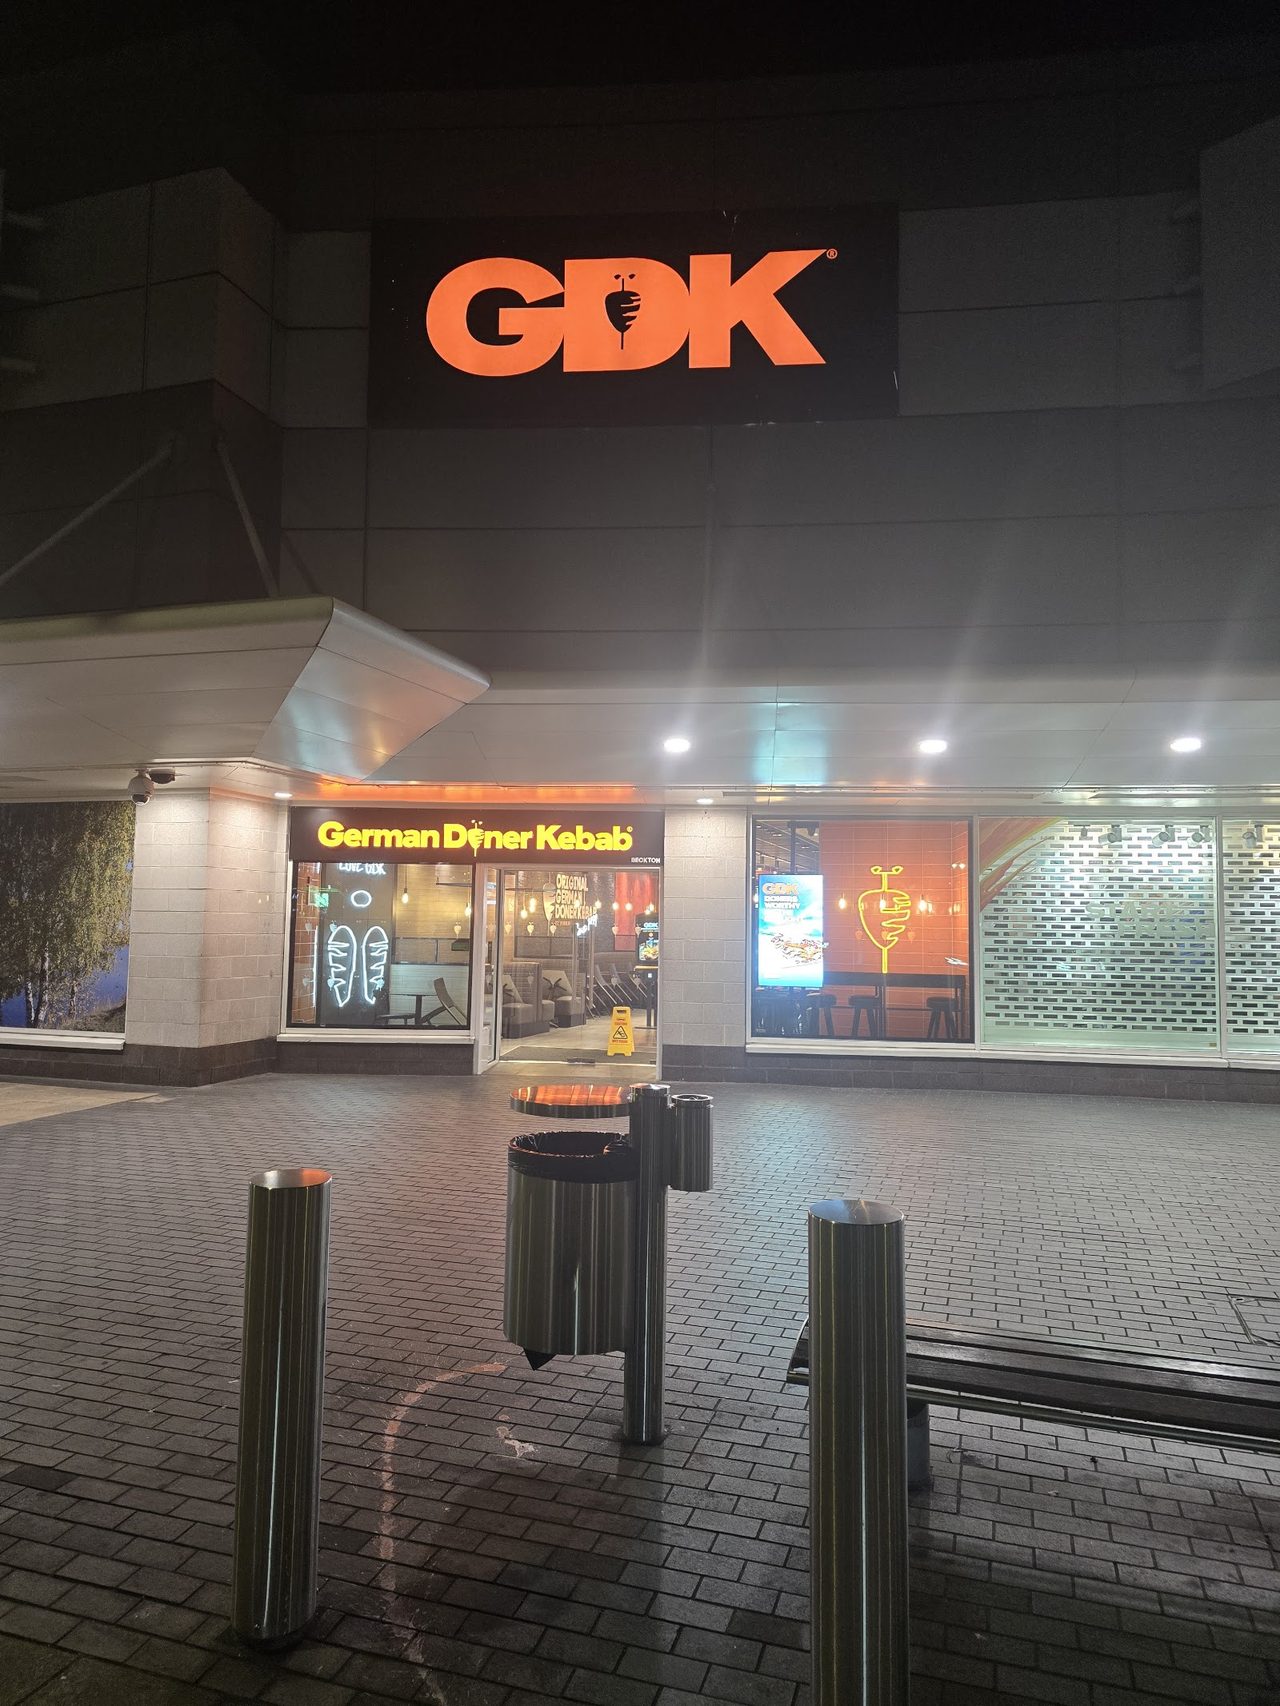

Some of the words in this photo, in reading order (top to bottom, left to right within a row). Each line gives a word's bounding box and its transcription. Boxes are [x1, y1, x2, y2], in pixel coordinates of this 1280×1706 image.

[426, 249, 827, 376] GDK
[318, 821, 440, 848] German
[536, 824, 633, 851] Kebab
[630, 856, 661, 864] BECKTON
[556, 873, 589, 891] ORIGINAL
[762, 882, 800, 895] GDK
[555, 889, 583, 906] GERMAN
[554, 904, 577, 919] DONER
